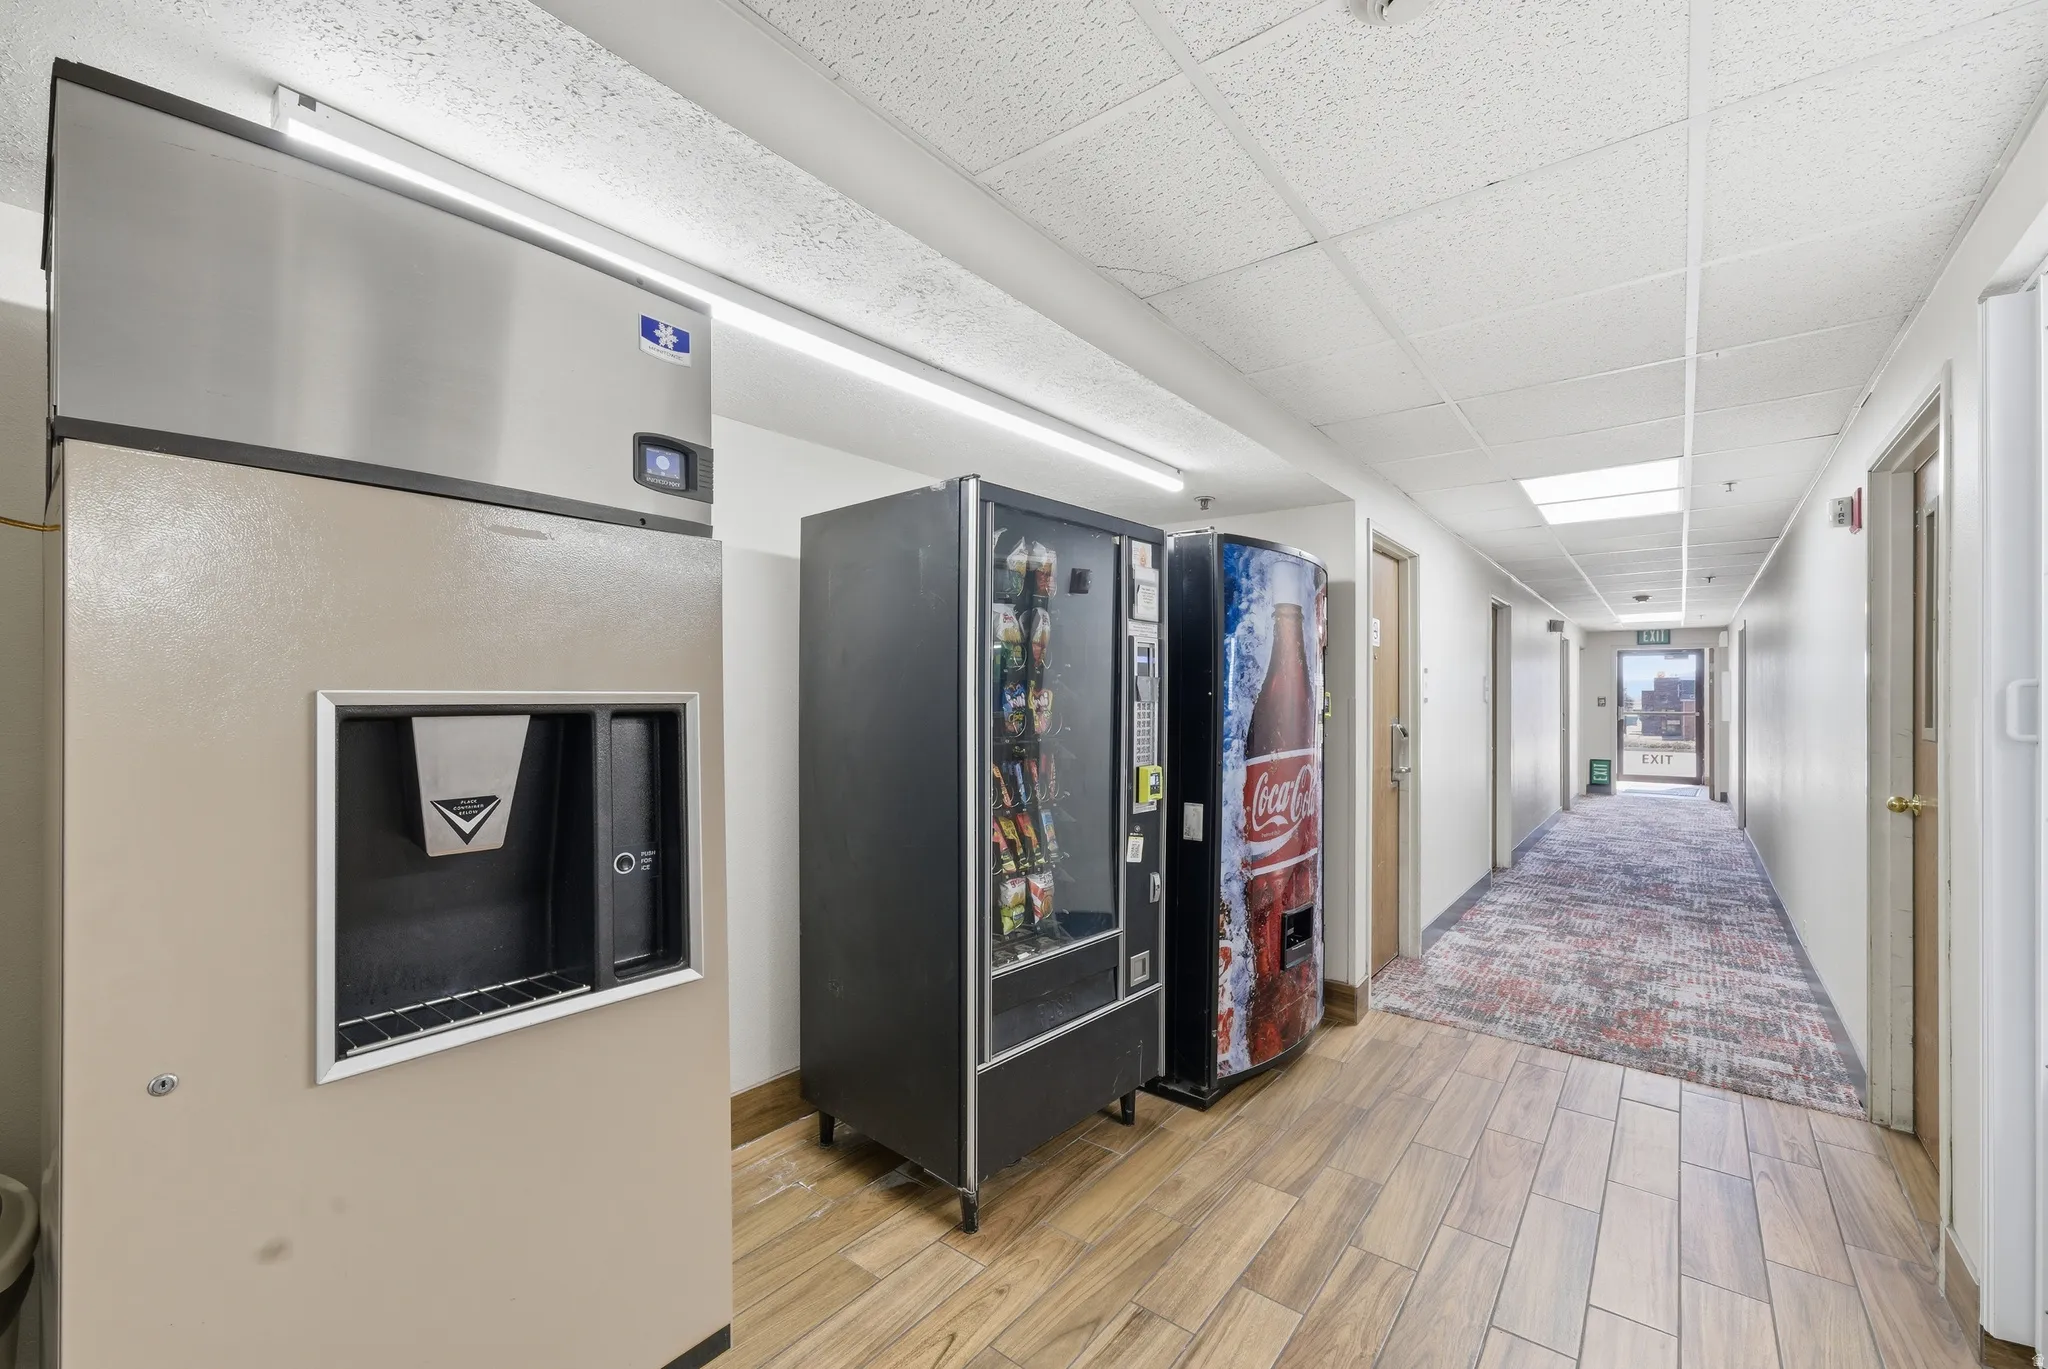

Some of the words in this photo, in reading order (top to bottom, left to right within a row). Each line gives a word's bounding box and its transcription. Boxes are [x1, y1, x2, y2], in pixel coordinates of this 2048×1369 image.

[1837, 500, 1845, 524] FIRE
[1643, 630, 1665, 642] EXIT
[1642, 754, 1674, 765] EXIT
[1593, 763, 1608, 781] EXIT
[453, 803, 485, 811] CONTAINER
